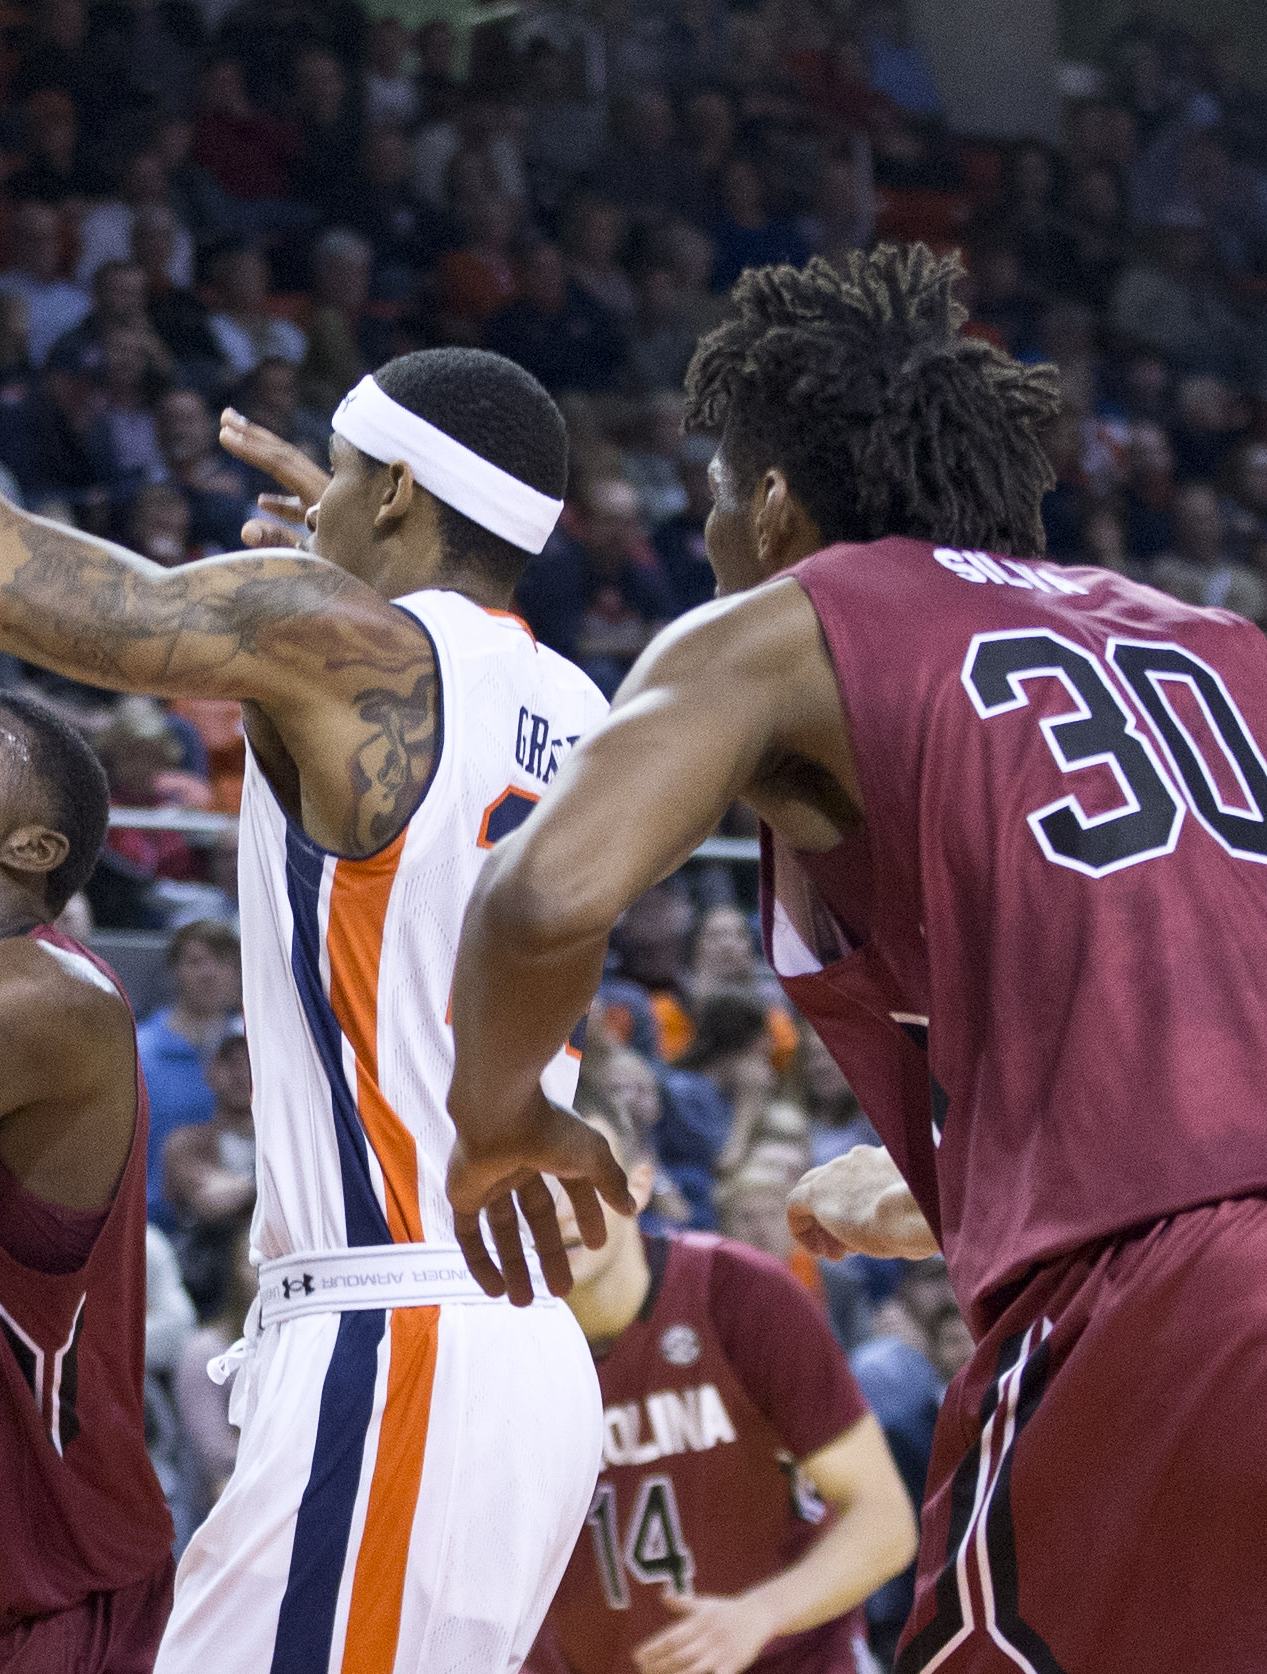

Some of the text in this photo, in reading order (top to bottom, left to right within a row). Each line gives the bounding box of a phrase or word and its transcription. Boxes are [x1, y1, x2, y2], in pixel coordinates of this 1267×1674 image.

[961, 627, 1267, 878] 30
[321, 1272, 404, 1290] ARMOUR
[601, 1384, 736, 1472] OLINA
[586, 1477, 695, 1610] 14
